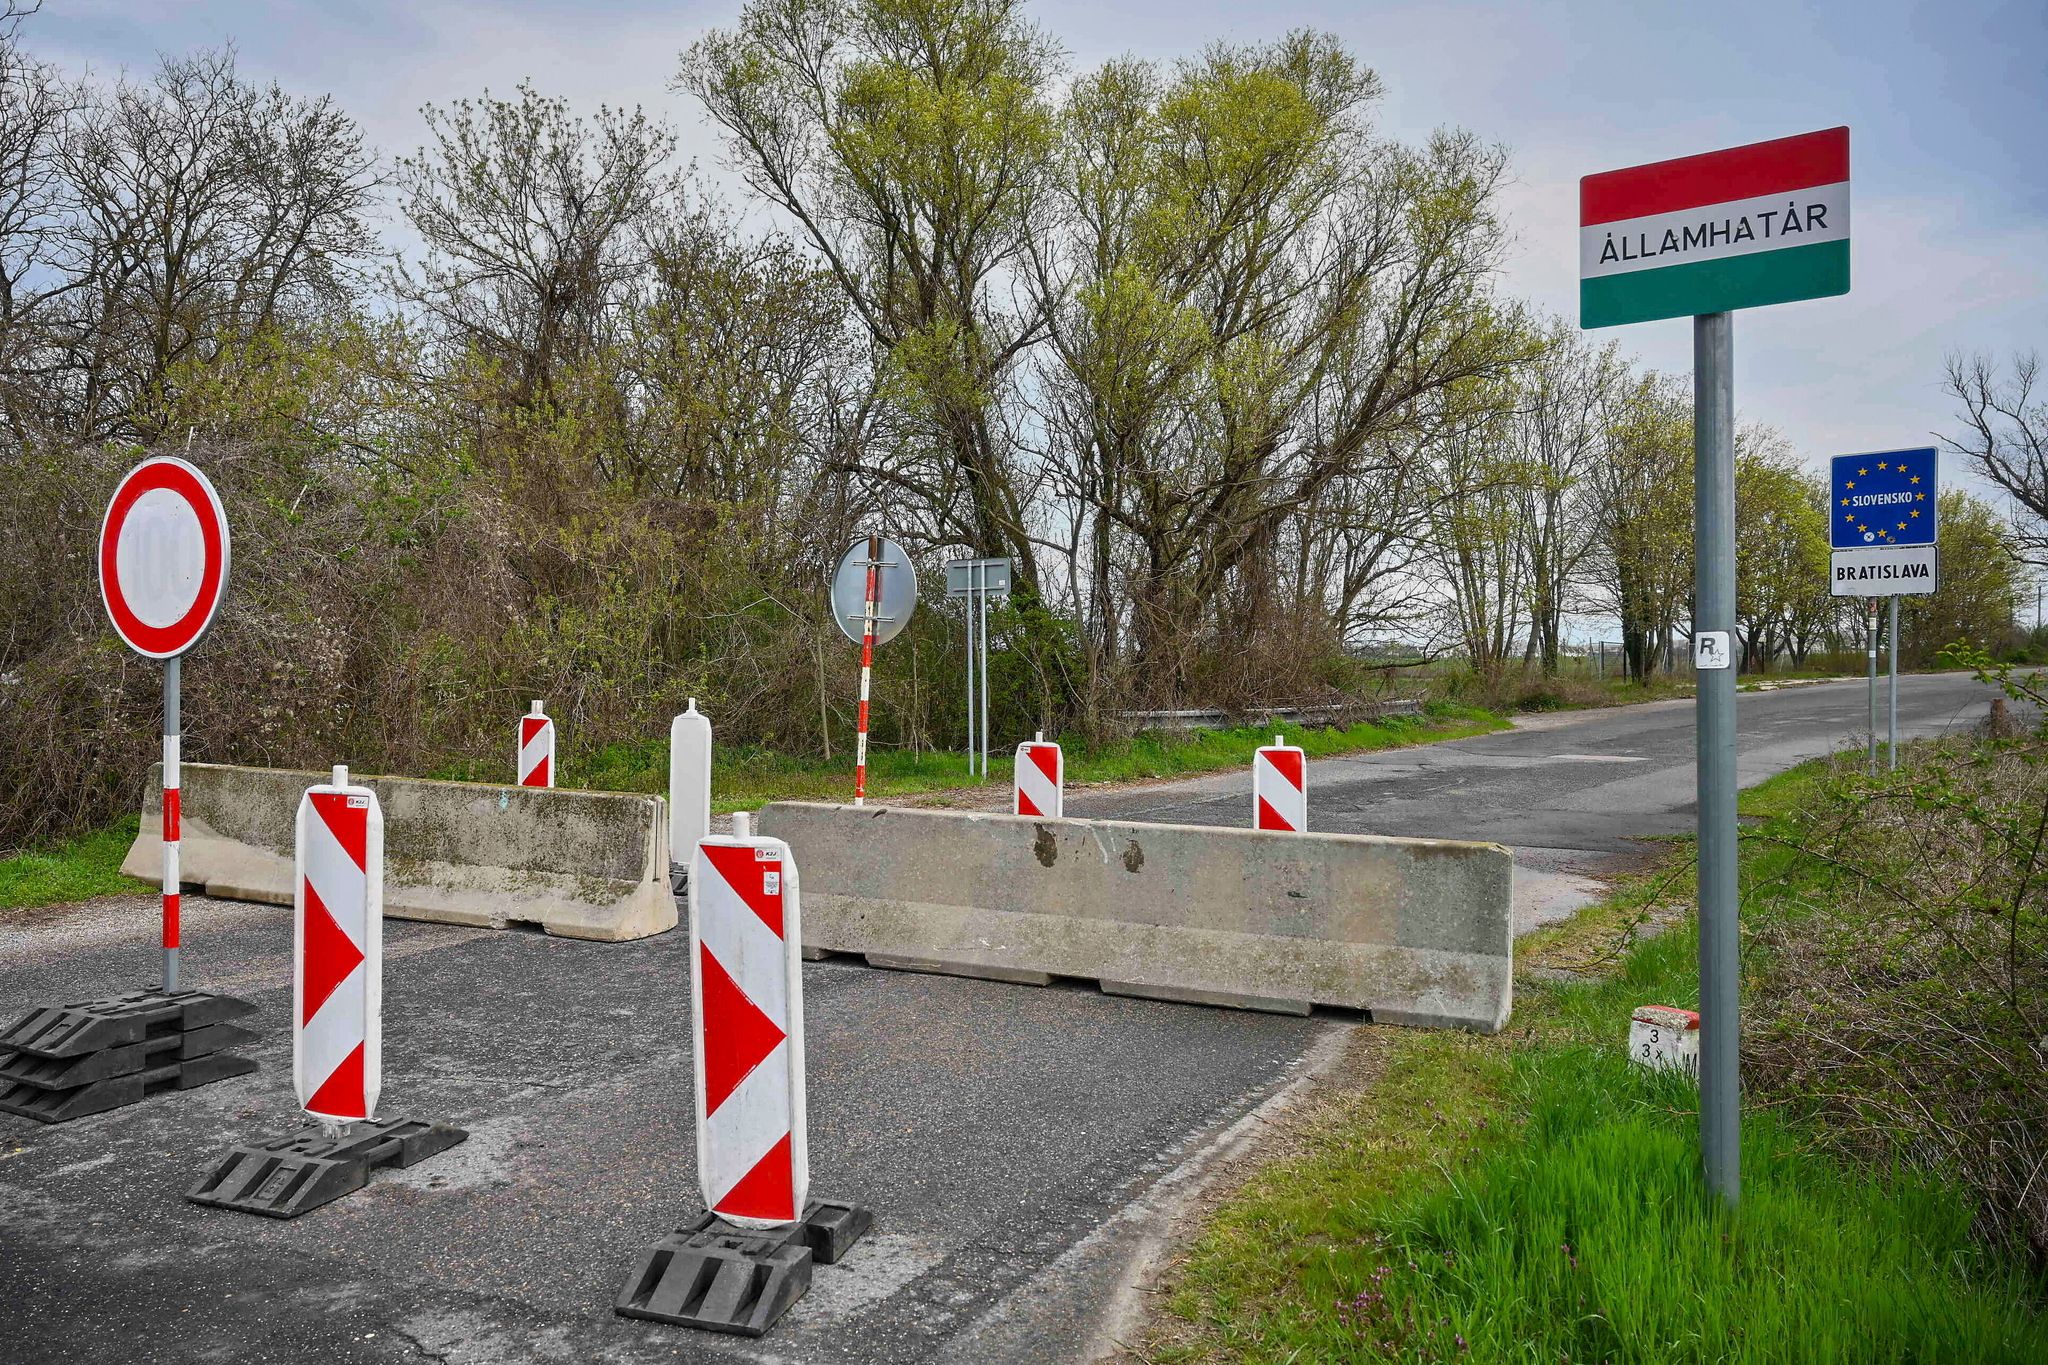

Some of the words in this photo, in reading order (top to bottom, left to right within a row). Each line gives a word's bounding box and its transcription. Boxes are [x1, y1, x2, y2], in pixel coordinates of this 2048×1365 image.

[1852, 491, 1913, 507] SLOVENSKO
[1836, 563, 1930, 581] BRATISLAVA
[1649, 1029, 1659, 1044] 3
